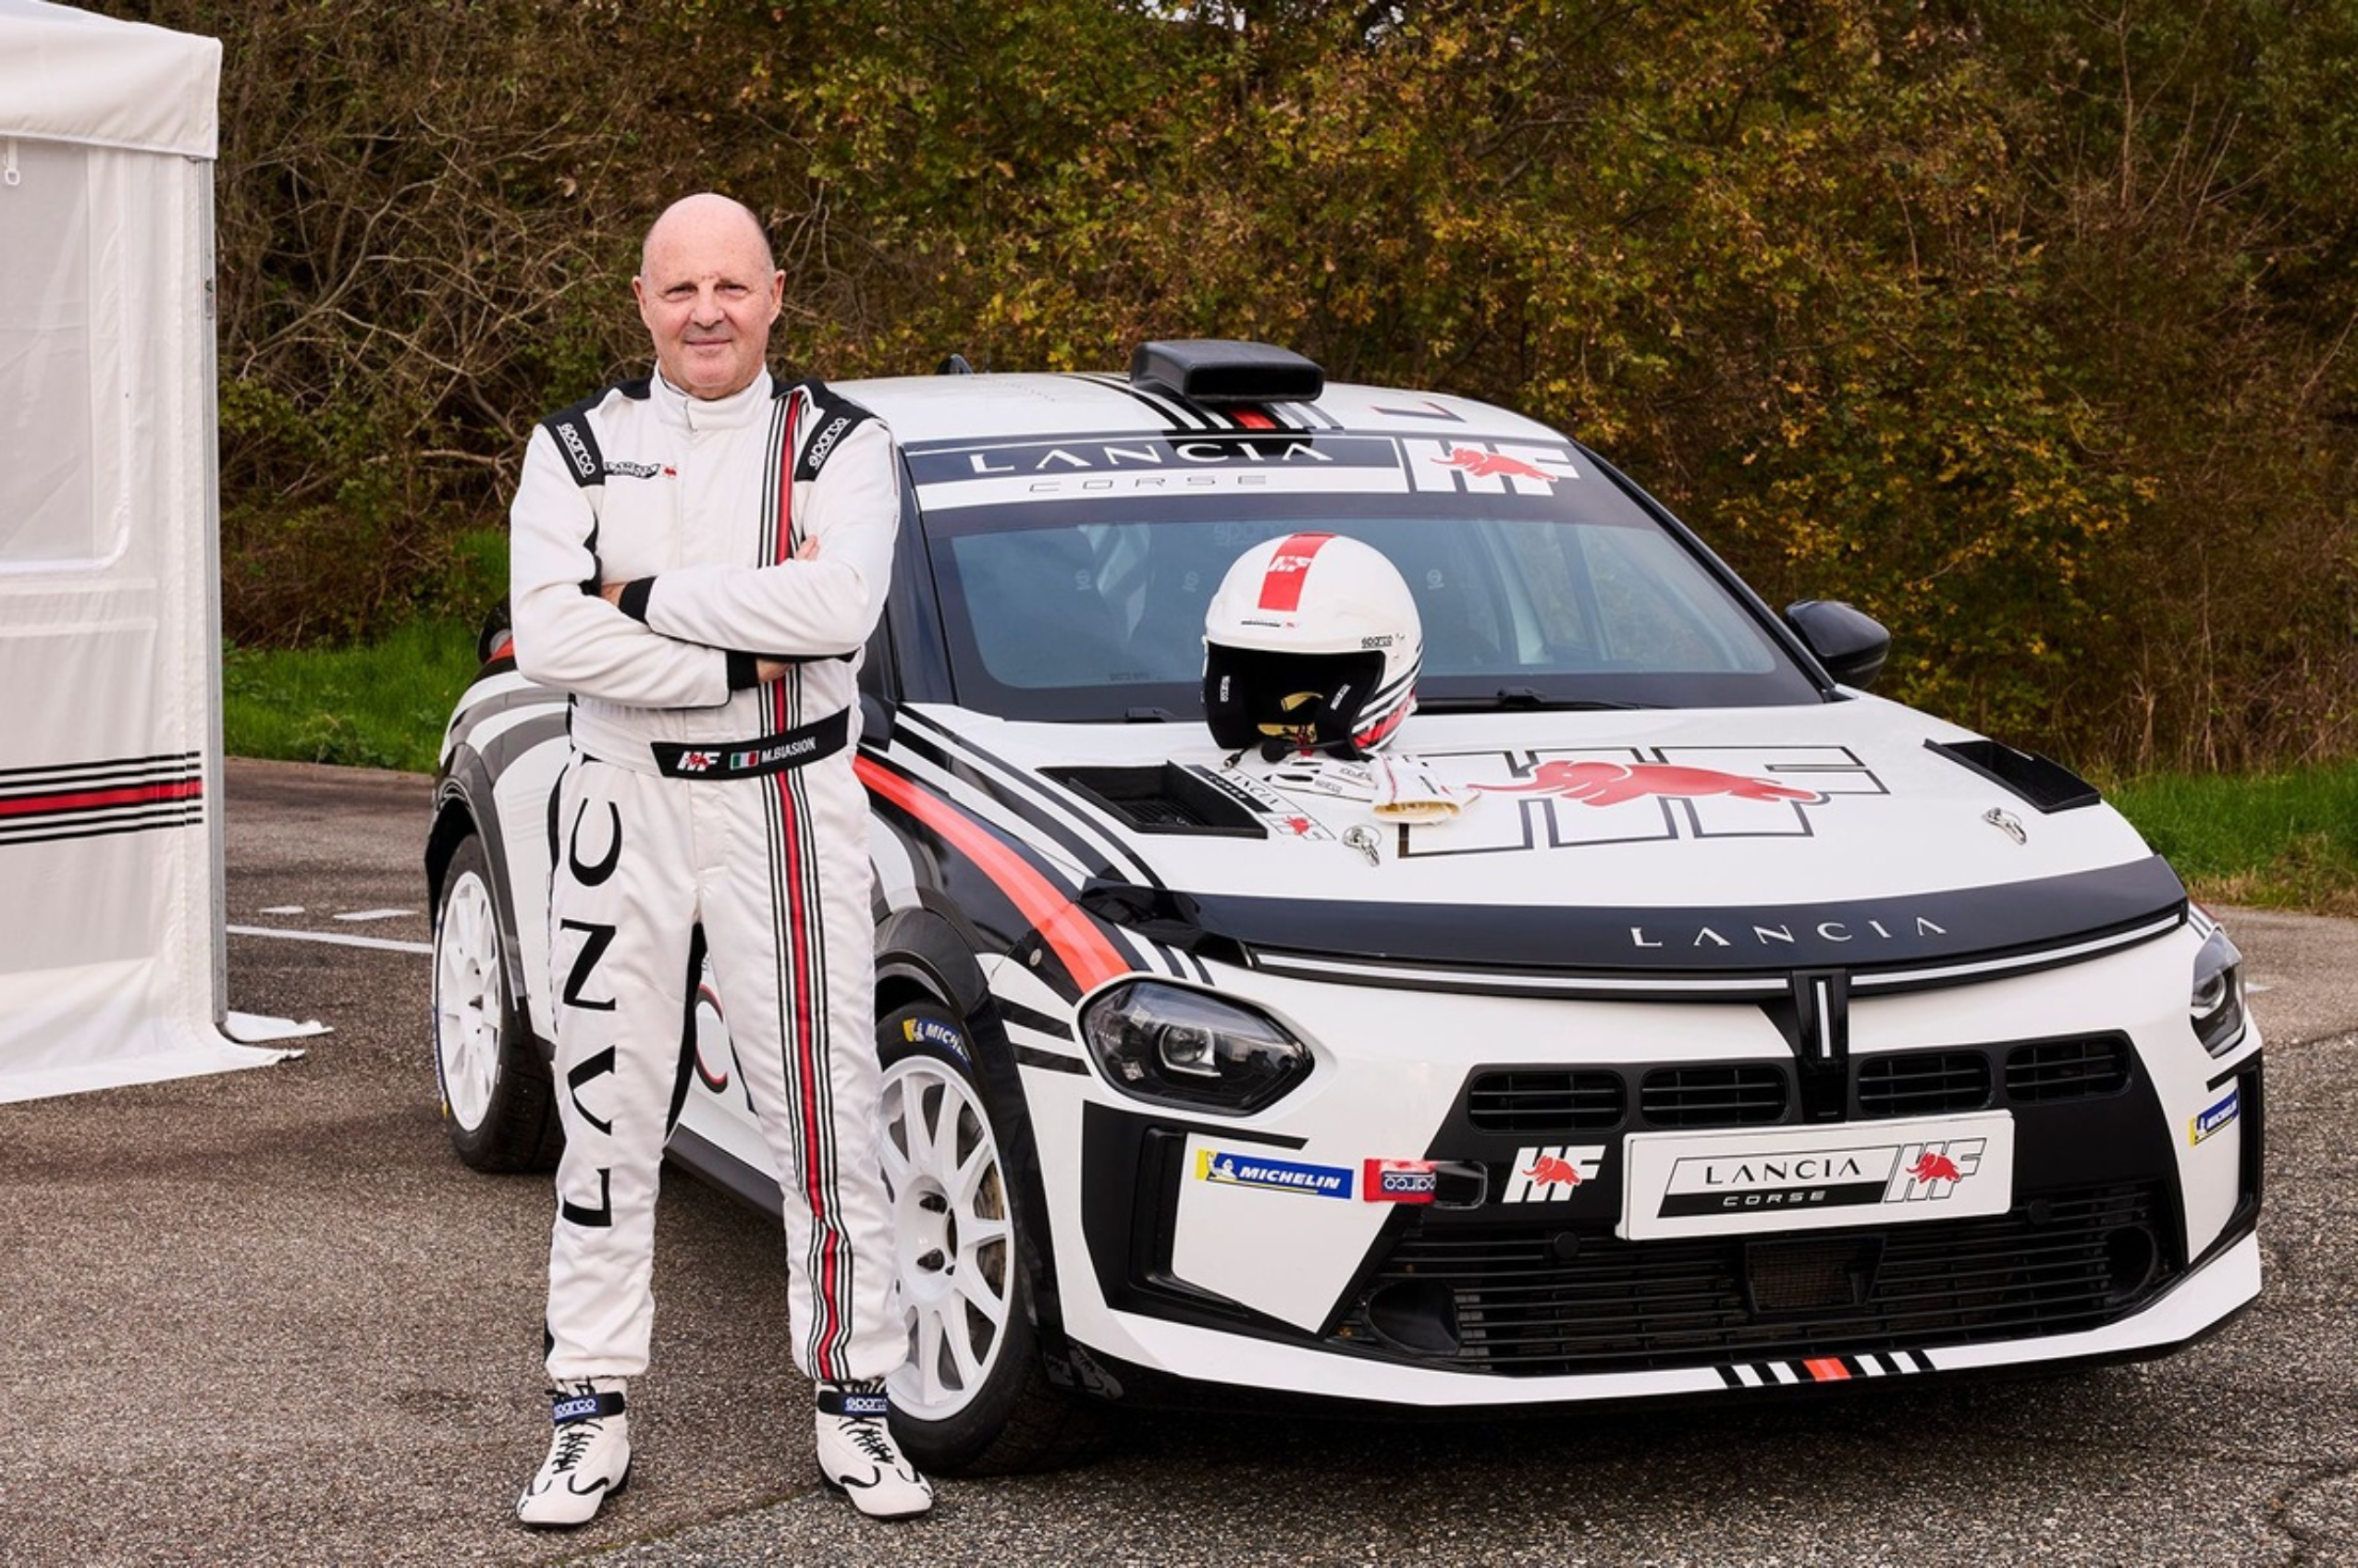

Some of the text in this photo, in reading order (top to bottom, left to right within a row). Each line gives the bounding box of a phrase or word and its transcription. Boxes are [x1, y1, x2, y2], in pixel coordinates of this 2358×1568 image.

[556, 423, 596, 478] sparco
[807, 417, 852, 471] sparco
[968, 442, 1333, 473] LANCIA
[1402, 437, 1579, 496] HF
[1028, 474, 1267, 492] CORSE
[678, 751, 721, 772] HF
[760, 737, 817, 764] M.BIASION
[1629, 915, 1947, 949] LANCIA
[1238, 1165, 1342, 1190] MICHELIN
[1503, 1145, 1606, 1204] HF
[1706, 1157, 1862, 1185] LANCIA
[1722, 1190, 1826, 1207] CORSE
[554, 1398, 596, 1419] parco
